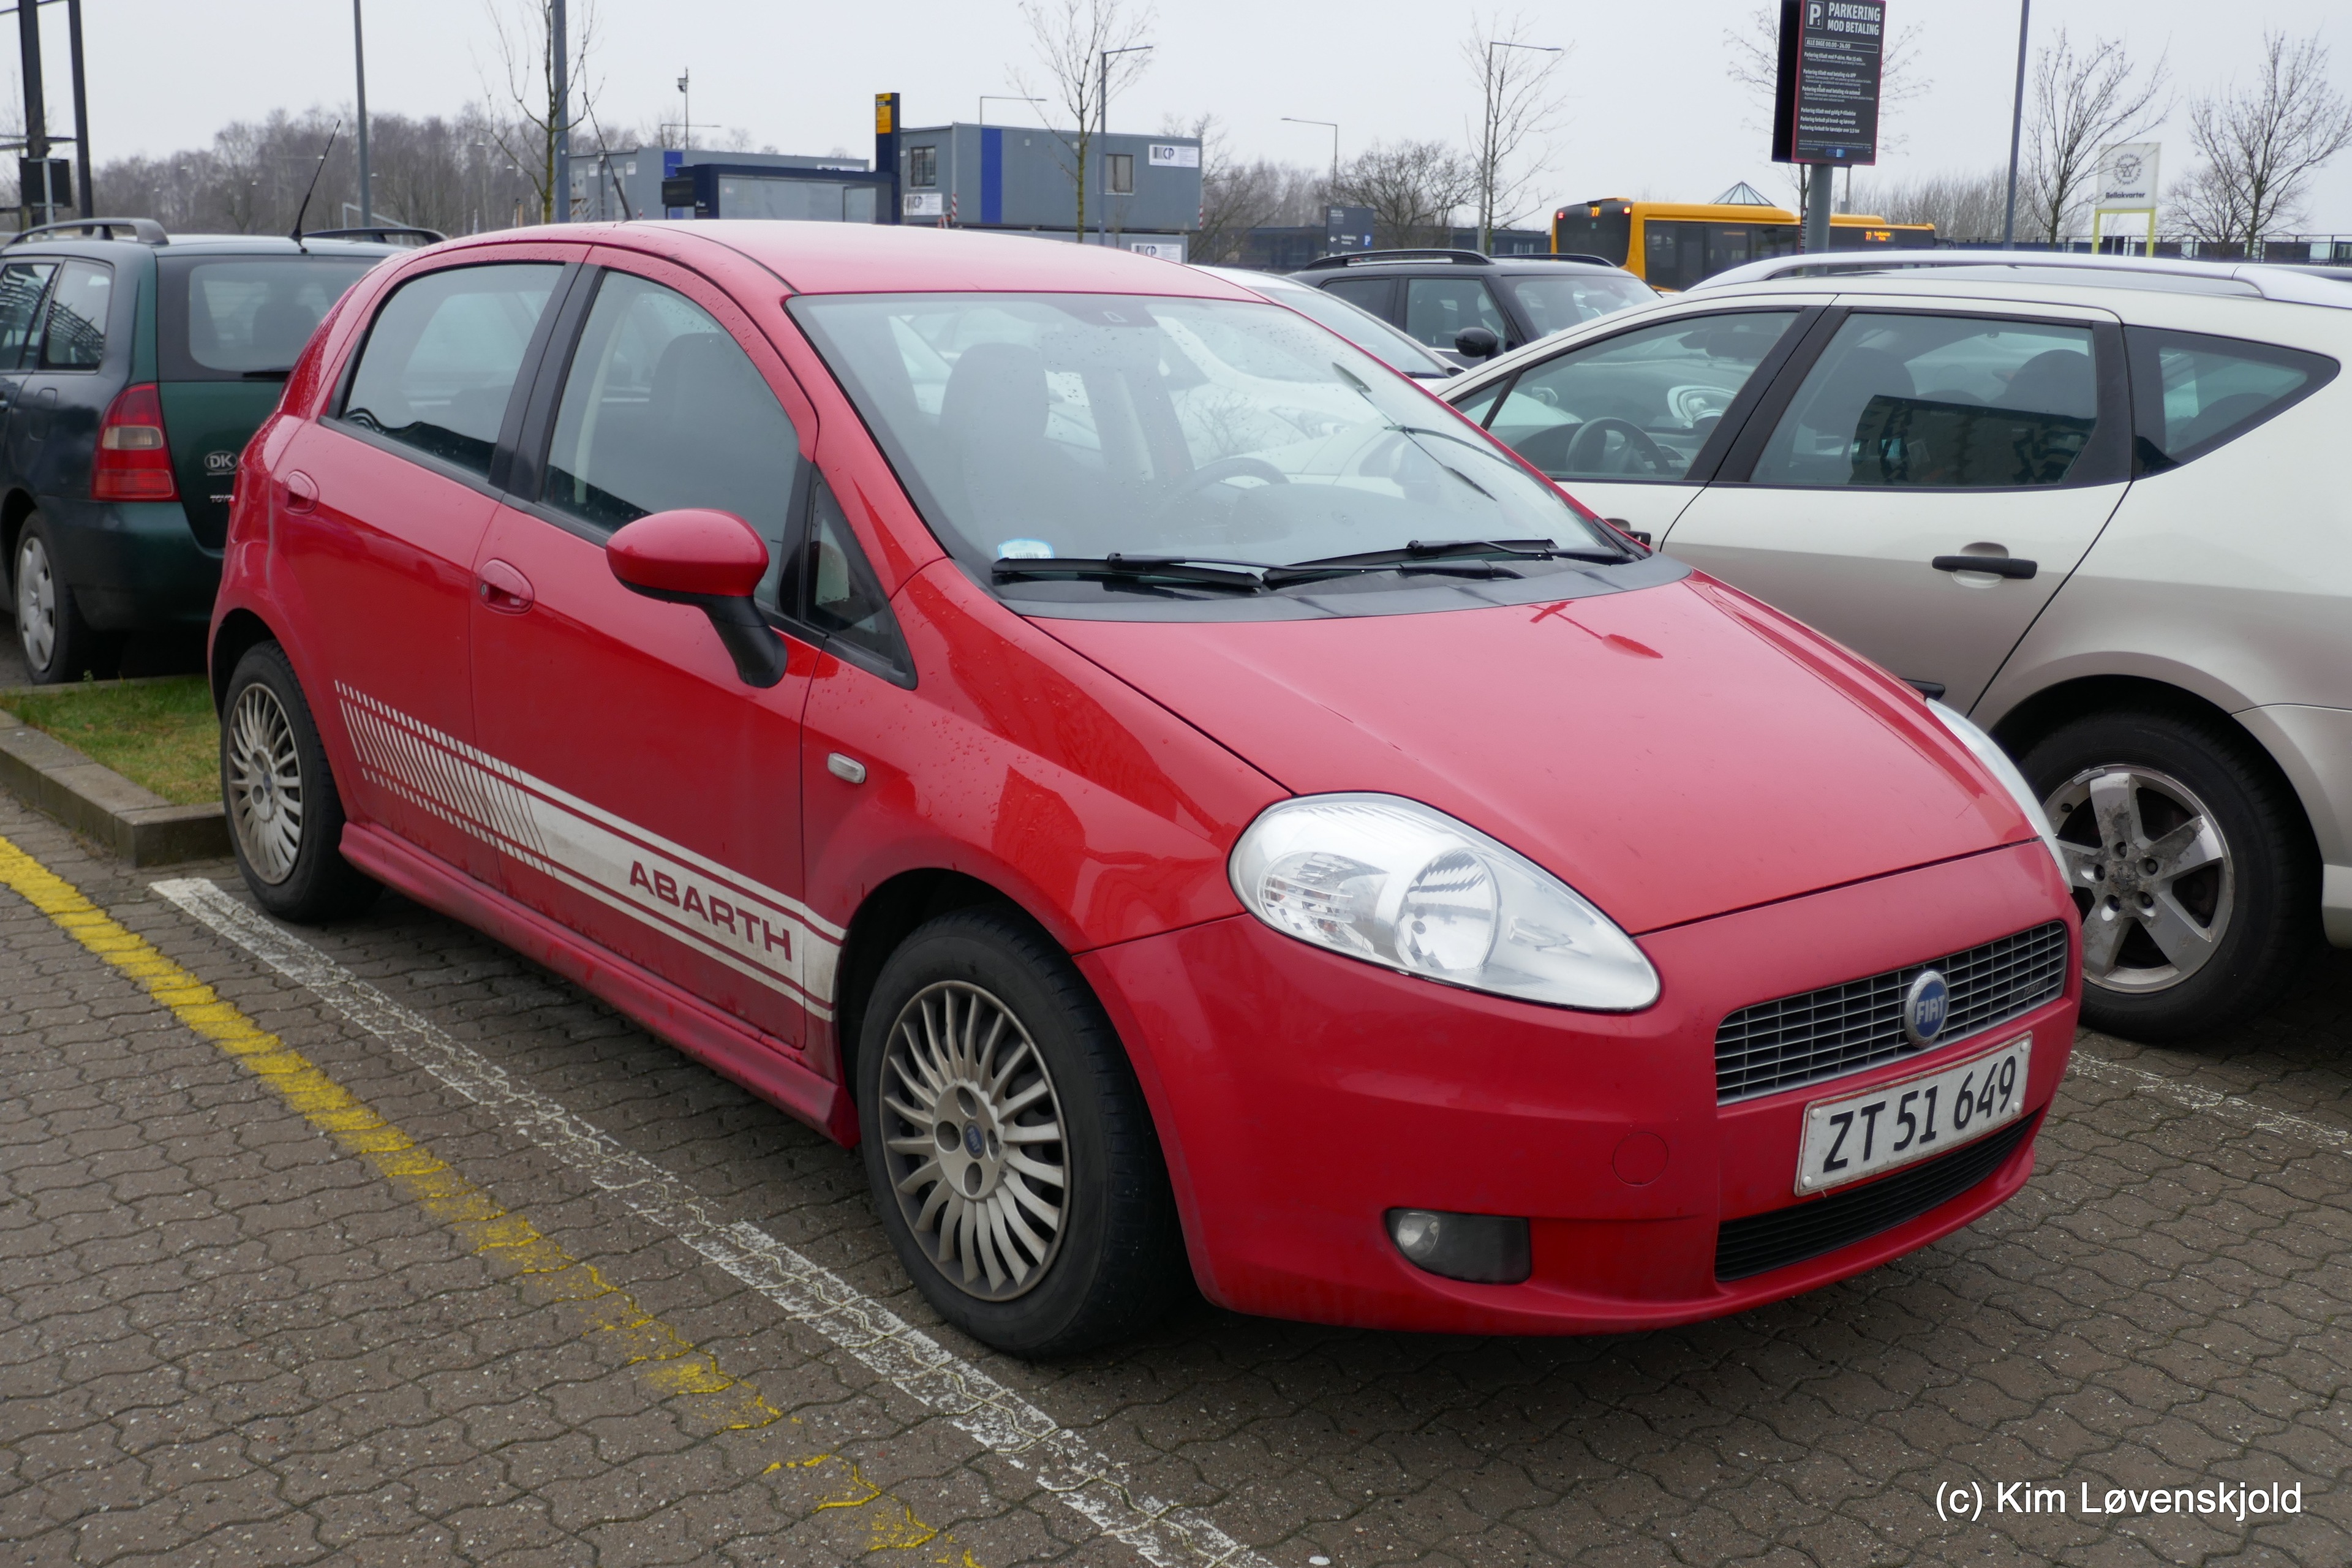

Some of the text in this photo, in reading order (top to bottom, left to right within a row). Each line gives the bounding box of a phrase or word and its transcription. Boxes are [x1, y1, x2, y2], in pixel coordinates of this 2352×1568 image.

[1828, 2, 1880, 21] PARKERING
[1827, 20, 1879, 36] MOD BETALING
[1591, 206, 1599, 217] 77
[1865, 232, 1872, 240] 77
[209, 455, 233, 468] DK
[630, 860, 793, 962] ABARTH
[1916, 995, 1945, 1025] FIAT
[1822, 1055, 2017, 1173] ZT 51 649
[967, 1127, 981, 1151] FIAT
